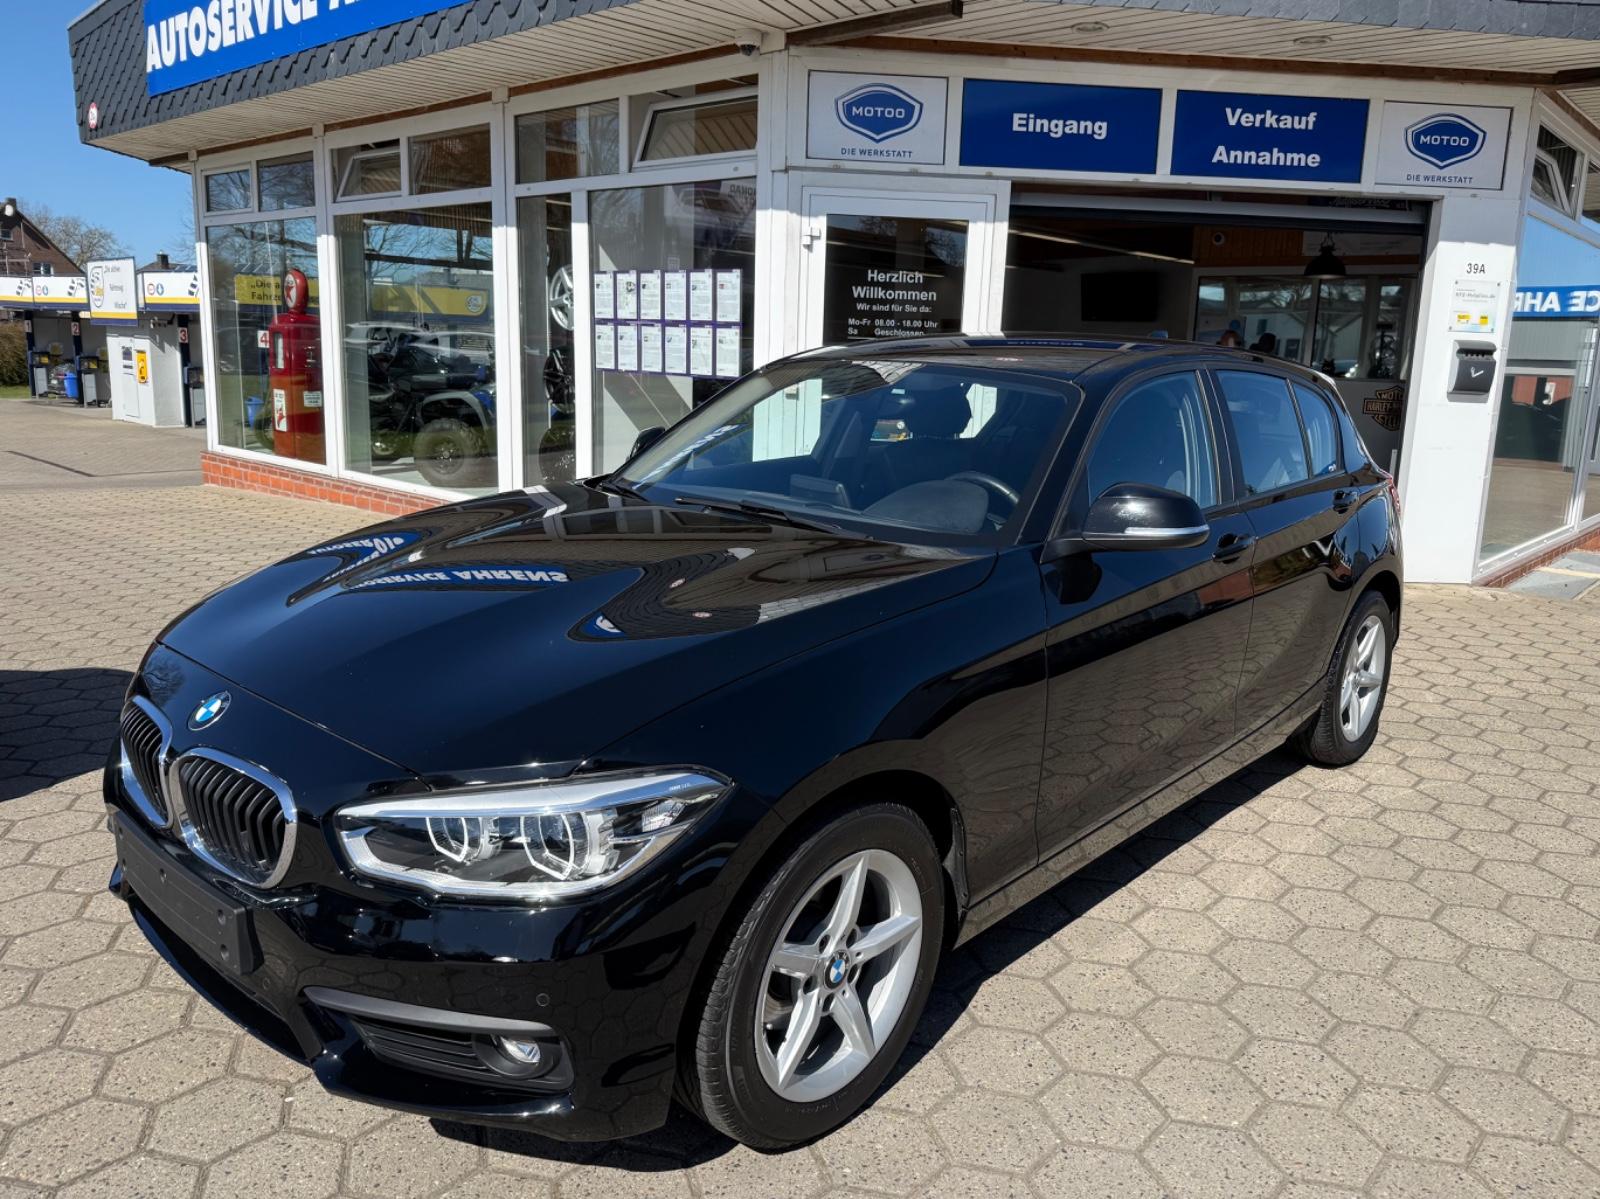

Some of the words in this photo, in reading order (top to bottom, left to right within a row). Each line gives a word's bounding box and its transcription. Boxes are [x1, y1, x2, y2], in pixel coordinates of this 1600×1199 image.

[852, 106, 905, 119] MOTOO
[1225, 107, 1318, 130] Verkauf
[1012, 113, 1108, 140] Eingang
[1419, 135, 1470, 147] MOTOO
[841, 148, 856, 156] DIE
[859, 148, 913, 158] WERKSTATT
[1211, 145, 1321, 167] Annahme
[1406, 174, 1421, 182] DIE
[1423, 175, 1473, 184] WERKSTATT
[1466, 263, 1486, 274] 39A
[867, 269, 923, 284] Herzlich
[852, 285, 937, 301] Willkommen
[856, 302, 871, 311] Wir
[872, 303, 890, 312] sind
[891, 303, 903, 312] für
[905, 304, 917, 313] Sie
[919, 305, 932, 313] da:
[848, 318, 872, 326] Mo-Fr
[923, 320, 939, 328] Uhr
[180, 329, 187, 342] 3
[847, 327, 858, 335] Sa
[260, 333, 269, 346] 4
